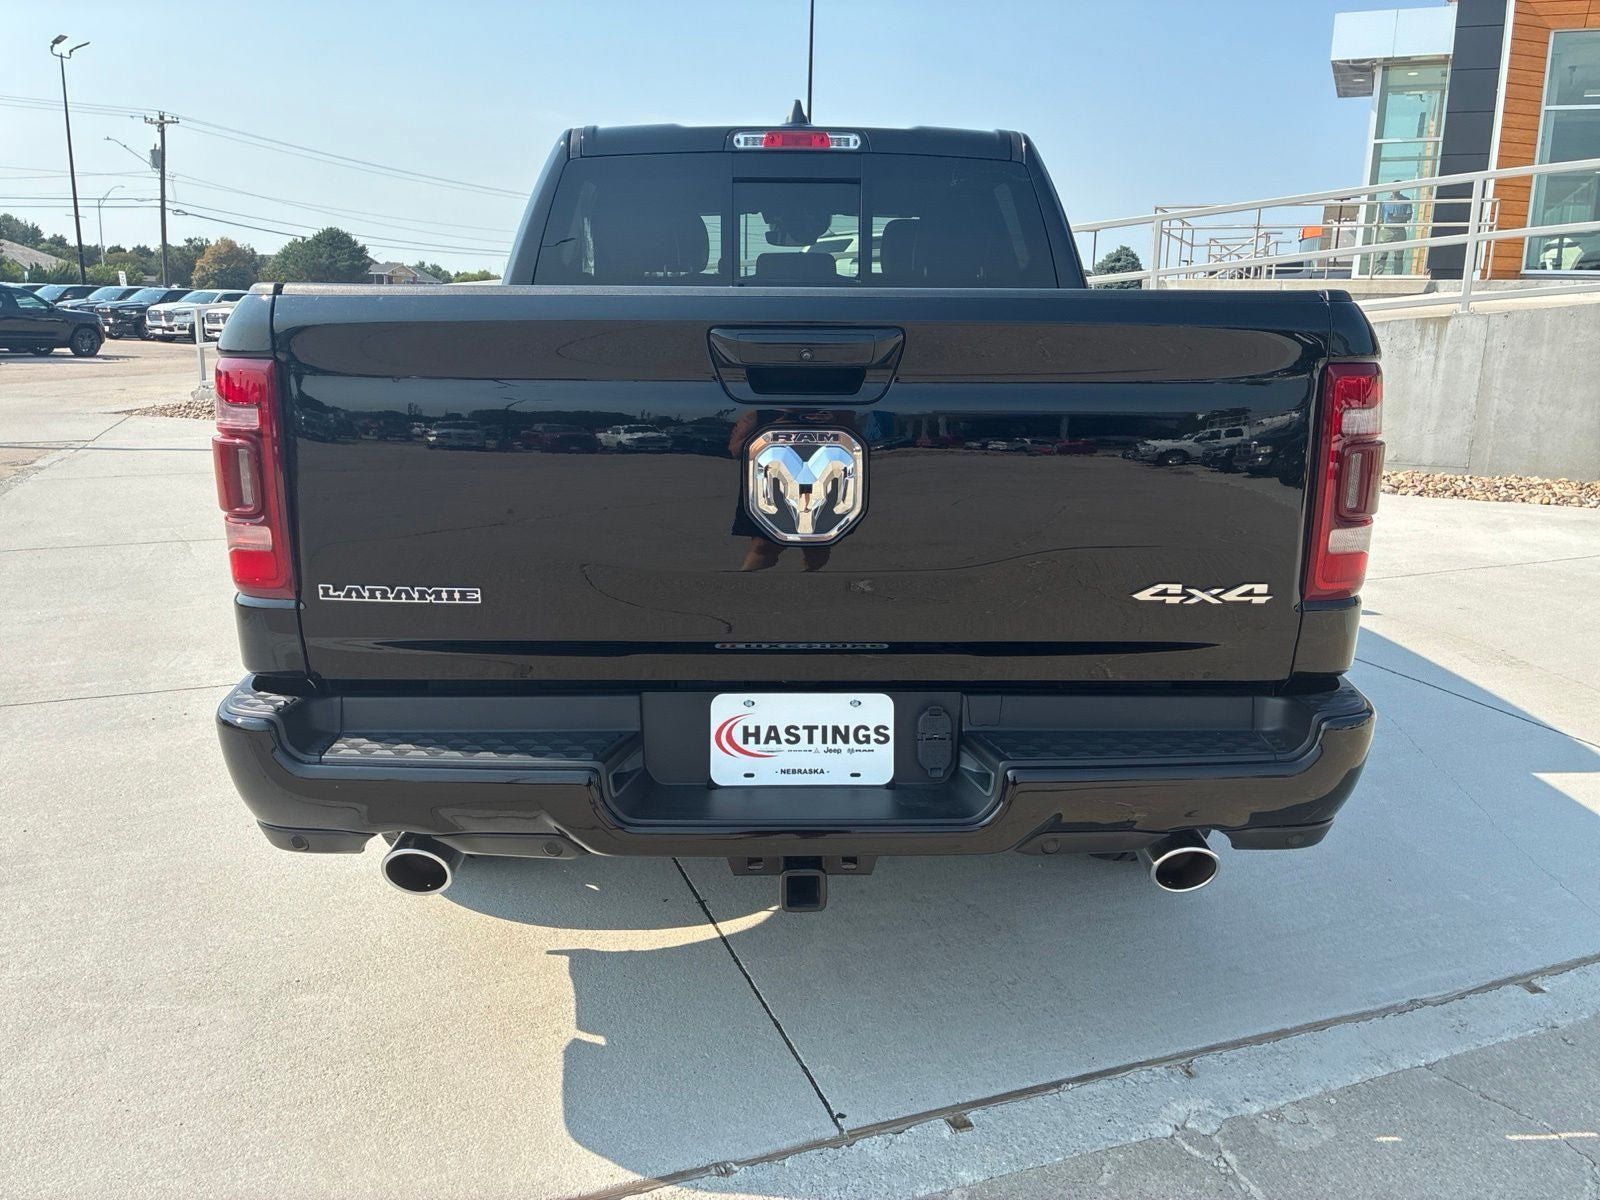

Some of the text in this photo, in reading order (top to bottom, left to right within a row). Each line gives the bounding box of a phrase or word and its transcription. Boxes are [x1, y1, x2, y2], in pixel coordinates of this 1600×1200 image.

[770, 432, 839, 443] RAM
[318, 584, 482, 604] LARAMIE
[1131, 583, 1273, 604] 4x4
[742, 724, 891, 745] HASTINGS
[823, 747, 842, 755] Jeep
